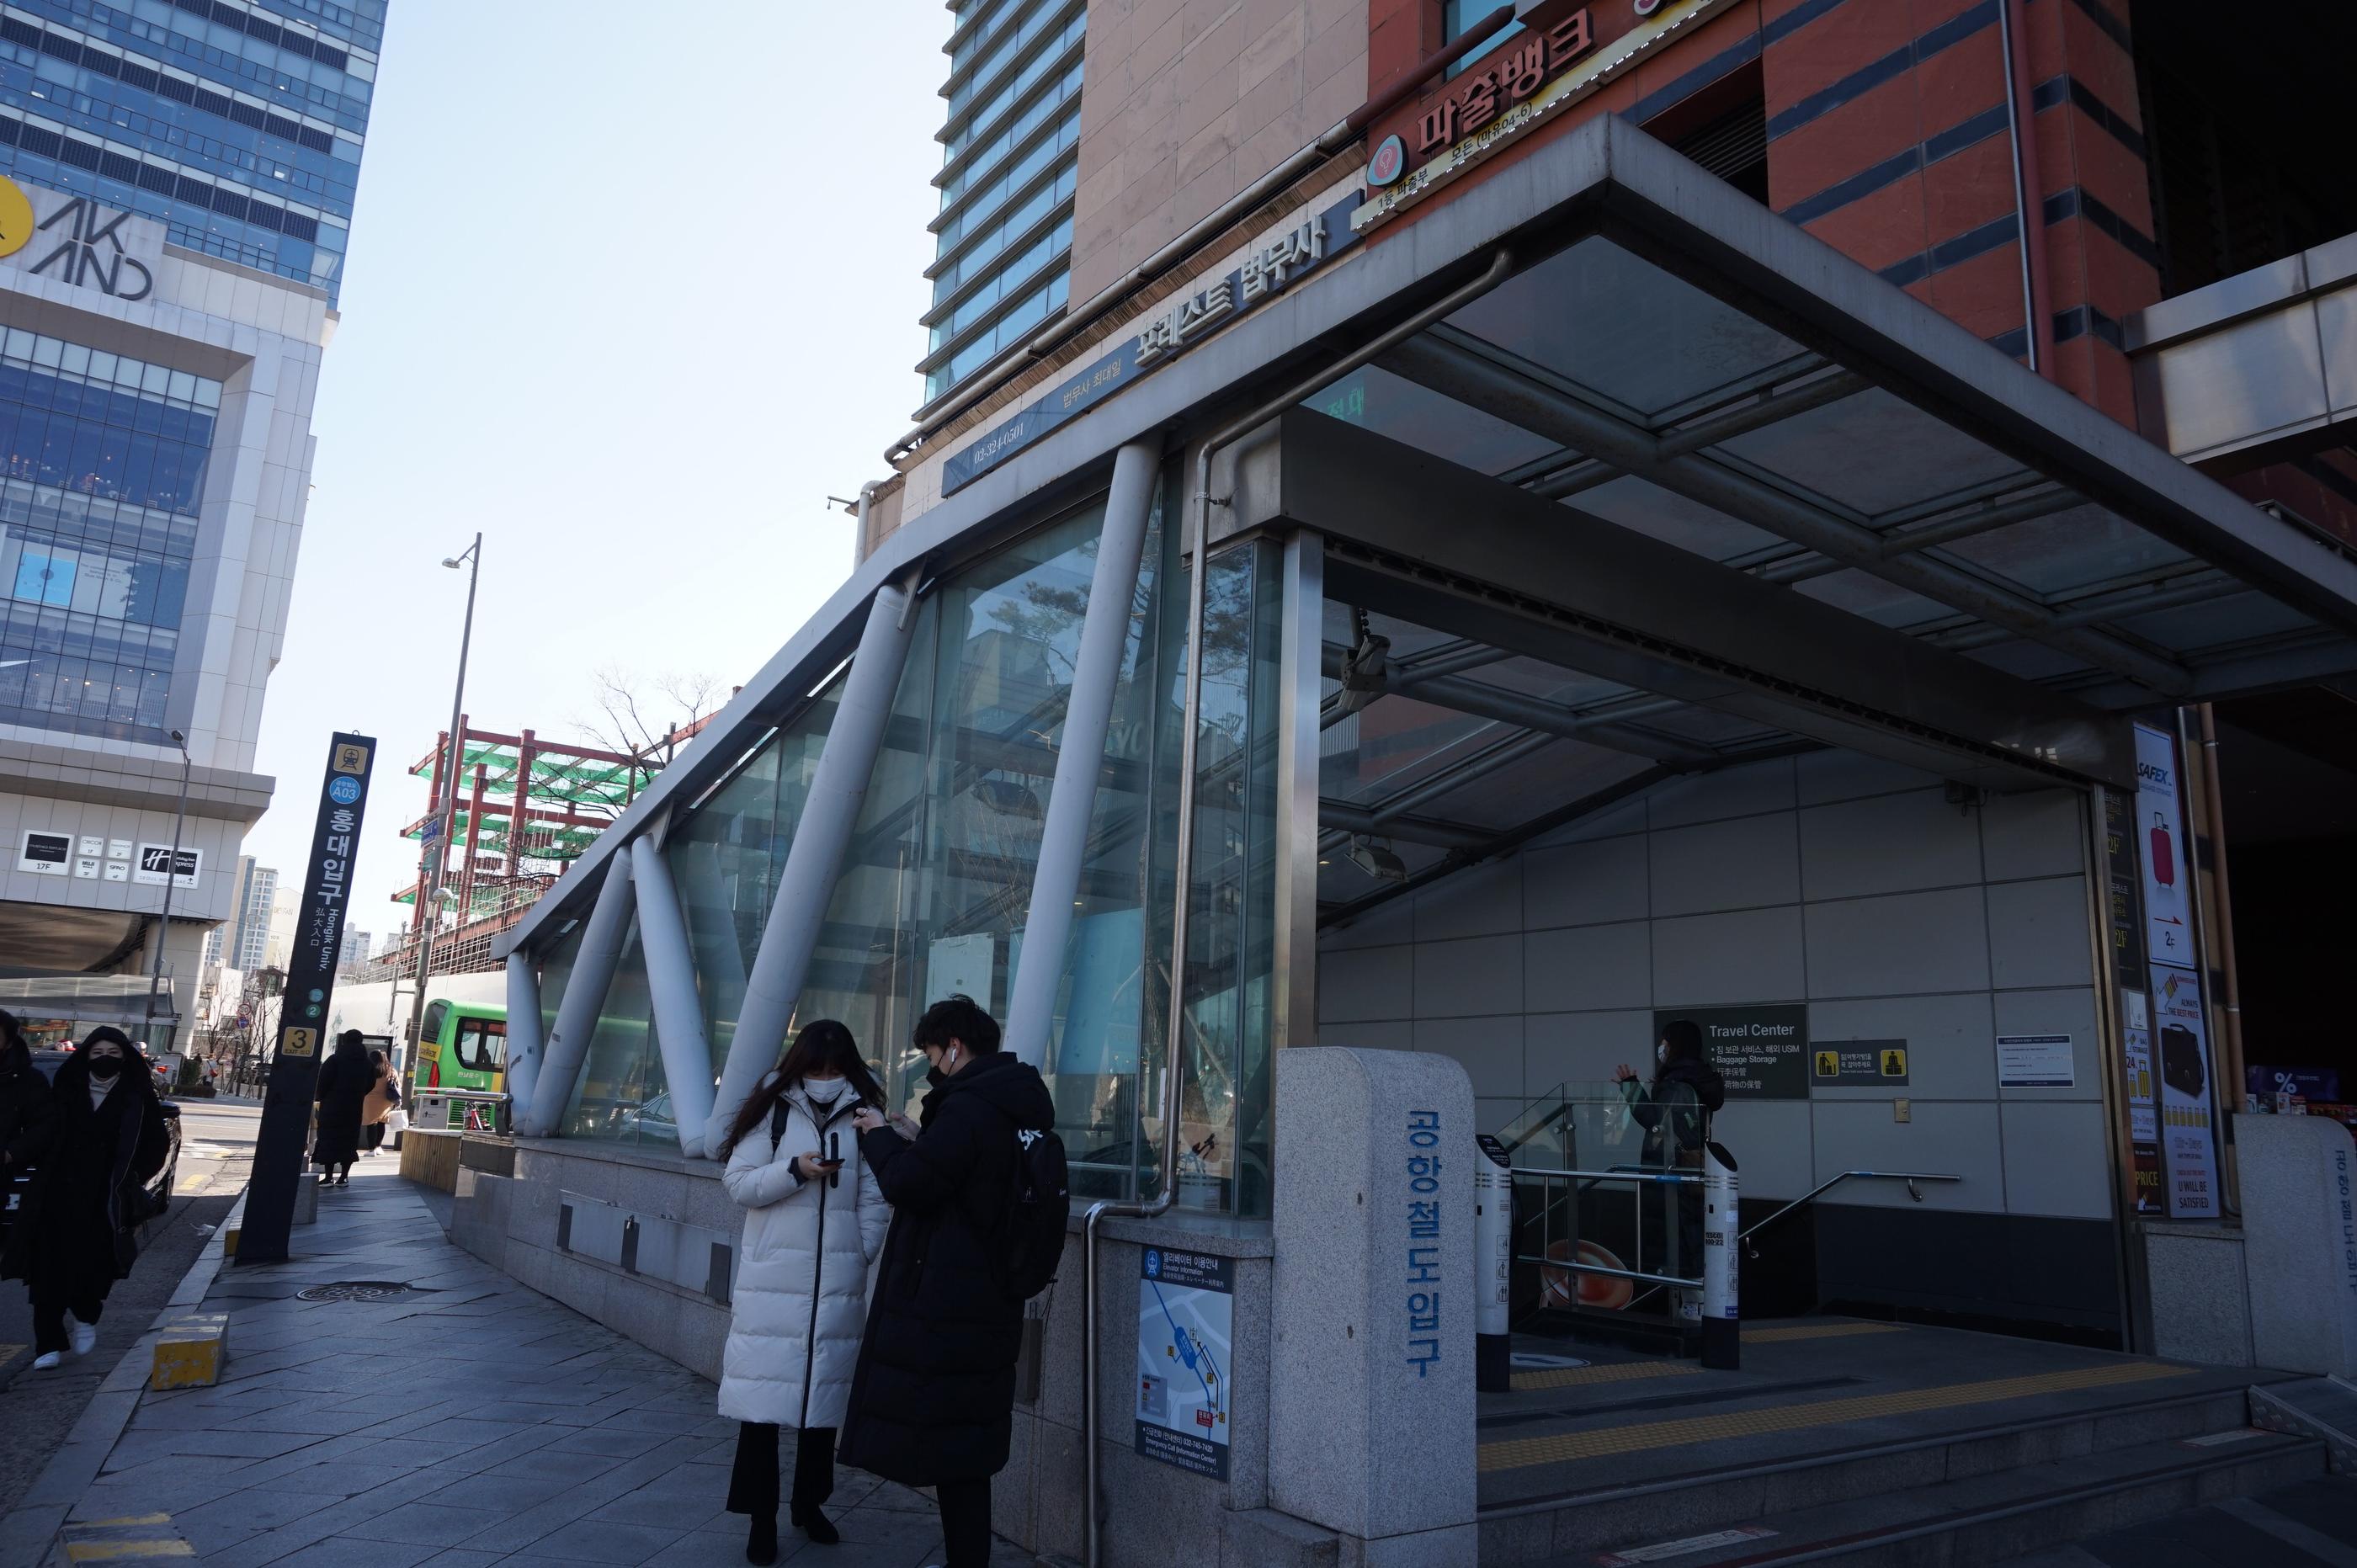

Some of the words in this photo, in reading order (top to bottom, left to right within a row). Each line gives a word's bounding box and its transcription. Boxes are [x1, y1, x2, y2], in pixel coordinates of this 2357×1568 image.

[1397, 168, 1429, 196] 파출부
[37, 197, 130, 253] AK
[29, 240, 152, 300] AND
[1135, 278, 1232, 367] 포레스트
[1241, 214, 1326, 303] 법무사
[1063, 379, 1091, 408] 법무사
[1093, 359, 1121, 388] 최대일
[974, 423, 1024, 464] 02-324-0501
[2138, 763, 2169, 783] SAFEX
[333, 787, 356, 800] A03
[318, 809, 354, 905] 홍대입구
[311, 907, 326, 947] 弘大入口
[323, 908, 339, 944] Hongik
[318, 946, 333, 972] Univ.
[309, 1007, 317, 1016] 2
[292, 1030, 307, 1049] 3
[1709, 1024, 1748, 1037] Travel
[1751, 1023, 1795, 1036] Center
[1716, 1055, 1748, 1065] Baggage
[1748, 1055, 1777, 1065] Storage
[1717, 1044, 1724, 1054] 짐
[1725, 1044, 1739, 1054] 보관
[1765, 1044, 1780, 1054] 해외
[1781, 1044, 1800, 1053] USIM
[2135, 1171, 2159, 1186] PRICE
[2184, 1181, 2199, 1193] WILL
[2199, 1181, 2207, 1192] BE
[2179, 1197, 2209, 1209] SATISFIED
[1407, 1110, 1442, 1379] 공항철도입구
[1163, 1252, 1192, 1266] 엘리베이터
[1194, 1256, 1219, 1271] 이용안내
[1163, 1262, 1179, 1272] Elevator
[1146, 1436, 1167, 1450] Emergency
[1176, 1445, 1200, 1460] (Information
[1200, 1454, 1217, 1466] Center)
